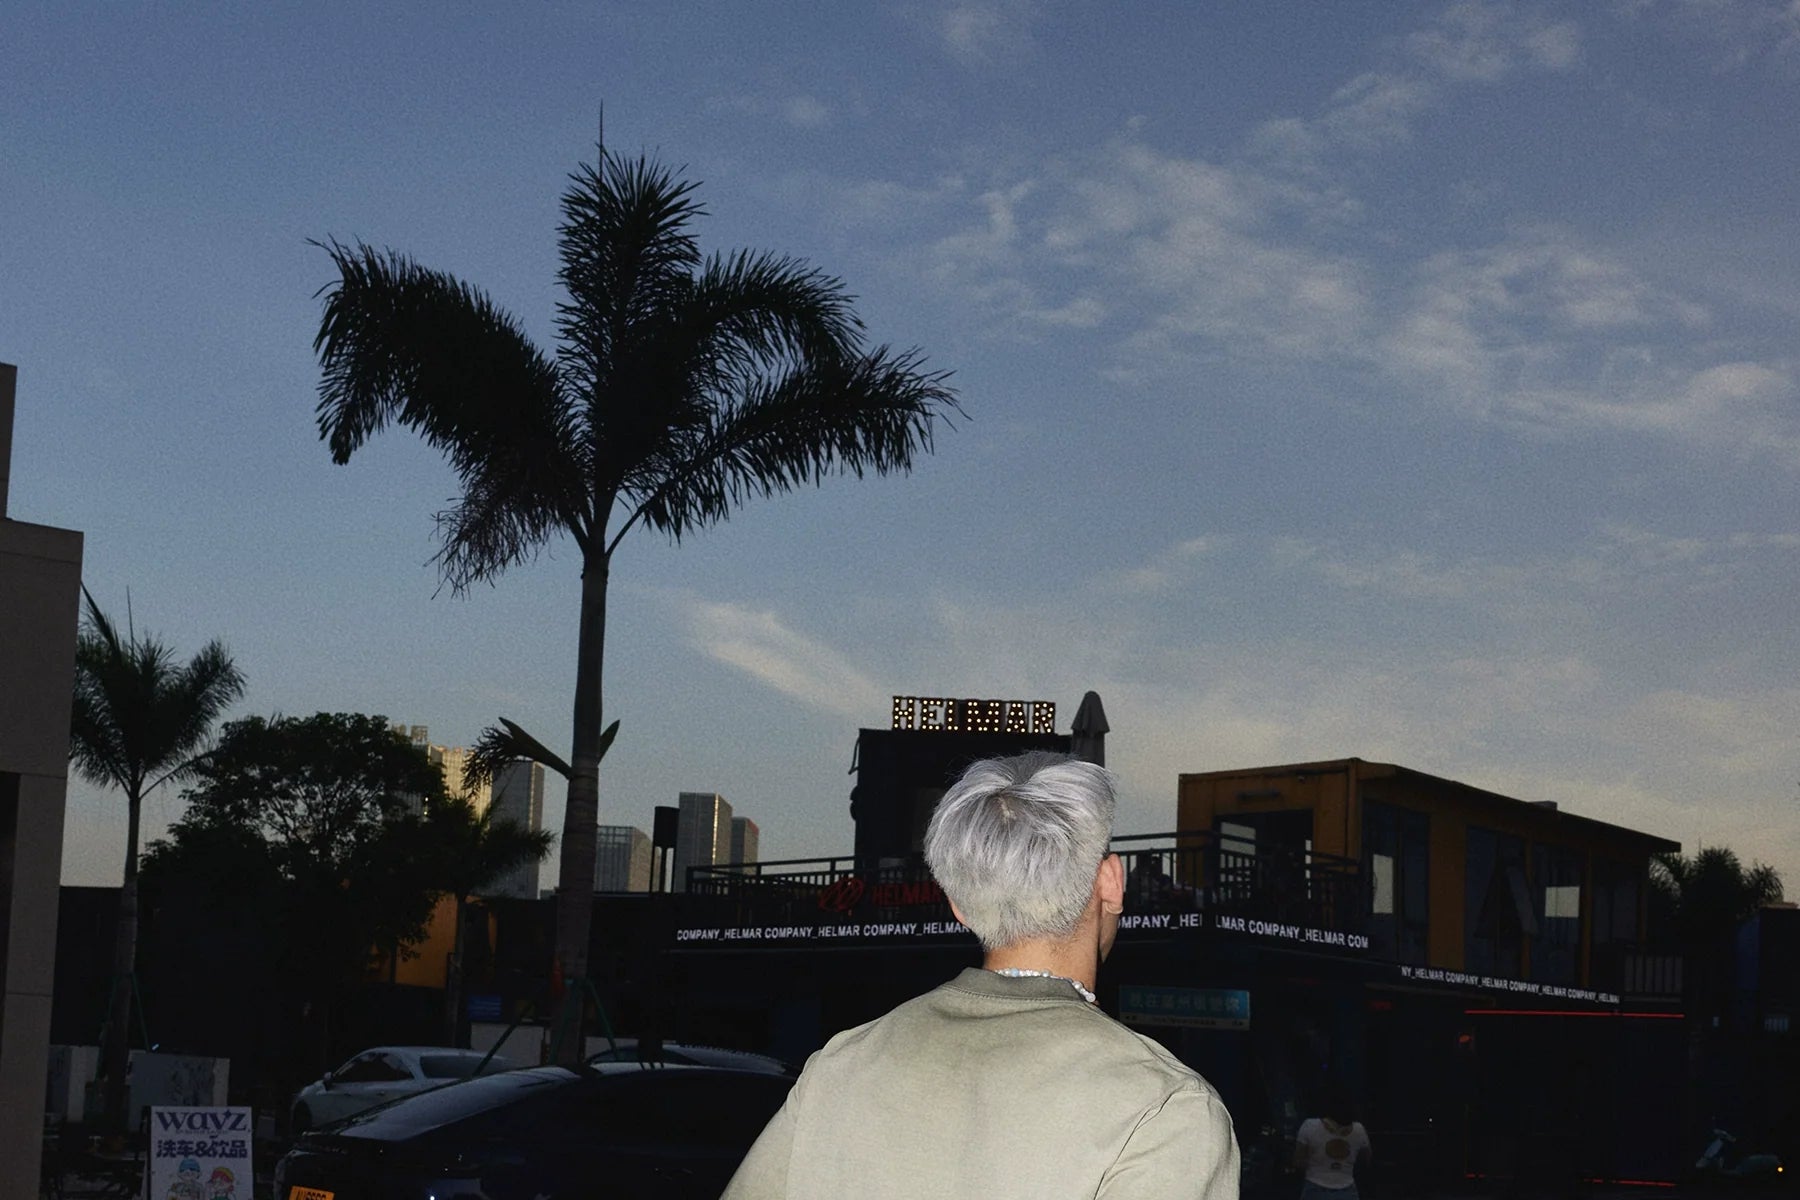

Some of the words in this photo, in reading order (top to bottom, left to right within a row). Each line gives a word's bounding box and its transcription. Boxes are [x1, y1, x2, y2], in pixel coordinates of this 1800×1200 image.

[892, 696, 1057, 735] HELMAR
[156, 1140, 248, 1158] 洗车&饮品
